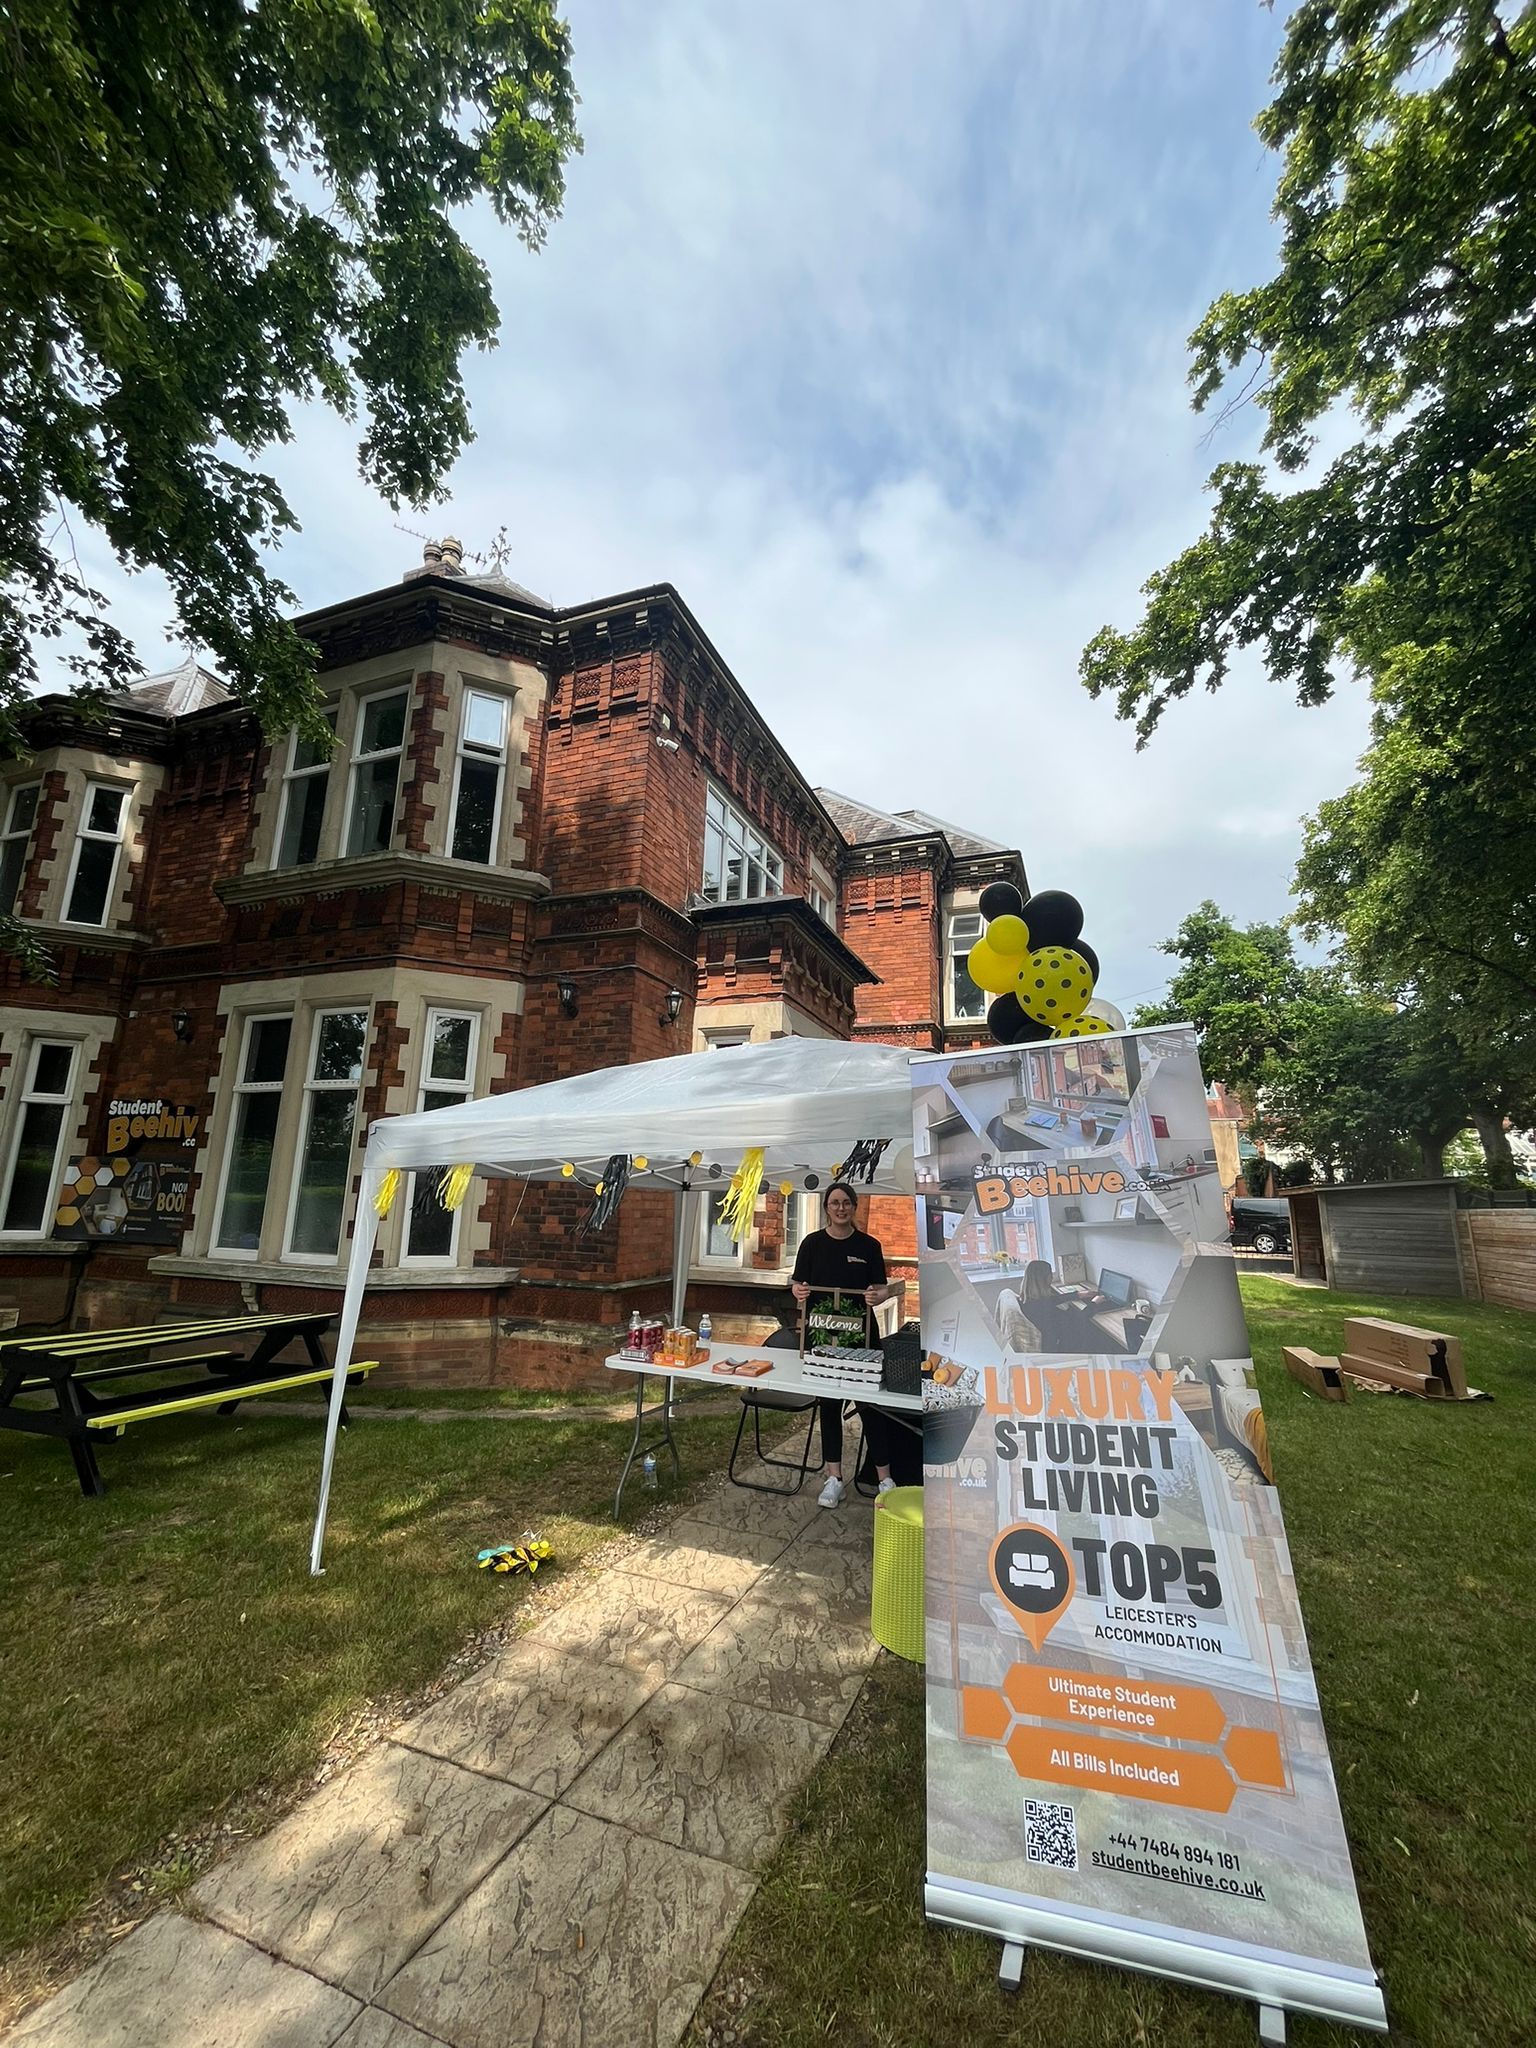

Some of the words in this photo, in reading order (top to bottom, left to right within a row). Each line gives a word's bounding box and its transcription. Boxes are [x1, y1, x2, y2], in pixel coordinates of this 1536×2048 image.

[108, 1100, 163, 1115] Student
[106, 1106, 199, 1154] Beehiv
[974, 1162, 1047, 1179] Student
[974, 1165, 1126, 1214] Beehive
[809, 1314, 862, 1331] Welcome
[984, 1366, 1178, 1421] LUXURY
[994, 1420, 1177, 1470] STUDENT
[1021, 1467, 1160, 1519] LIVING
[1072, 1536, 1223, 1610] TOP5
[1105, 1605, 1198, 1629] LEICESTER'S
[1094, 1624, 1223, 1654] ACCOMMODATION
[1048, 1676, 1112, 1700] Ultimate
[1115, 1686, 1177, 1709] Student
[1069, 1699, 1155, 1726] Experience
[1050, 1749, 1071, 1767] All
[1074, 1752, 1106, 1773] Bills
[1110, 1758, 1180, 1787] Included
[1109, 1832, 1137, 1850] +44
[1140, 1837, 1179, 1860] 7484
[1184, 1845, 1213, 1866] 894
[1217, 1851, 1241, 1872] 181
[1092, 1850, 1266, 1899] studentbeehive.co.uk
